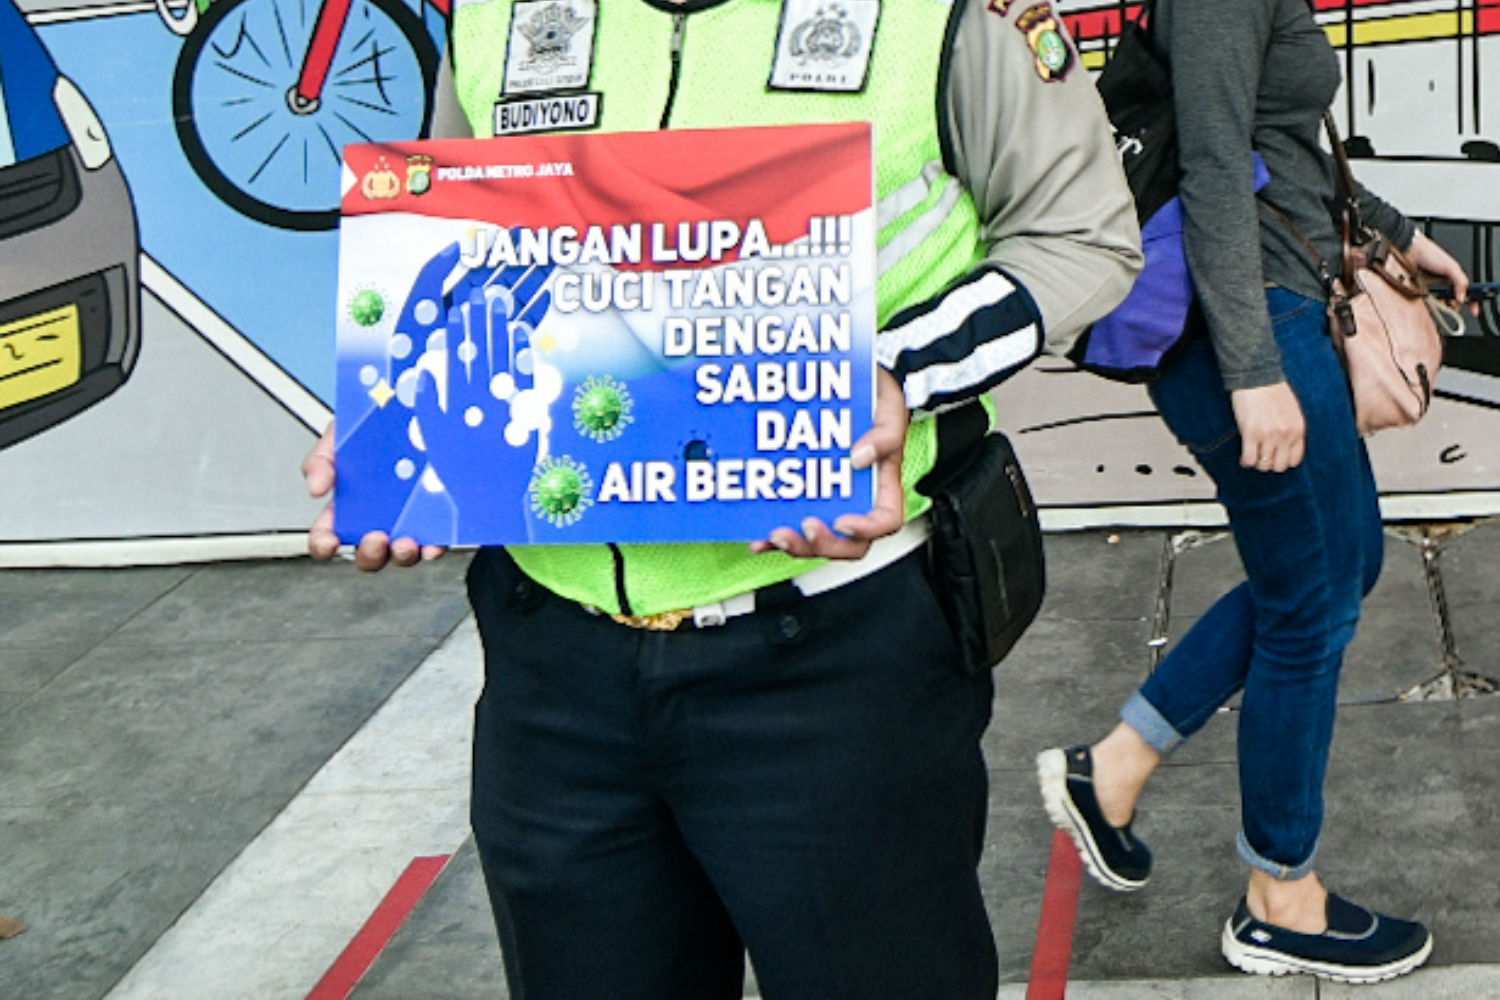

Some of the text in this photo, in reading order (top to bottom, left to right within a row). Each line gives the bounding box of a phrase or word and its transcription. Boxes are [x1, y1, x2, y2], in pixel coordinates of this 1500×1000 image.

[500, 98, 590, 131] BUDIYONO
[438, 166, 483, 180] POLDA
[536, 163, 574, 176] JAYA
[460, 223, 642, 269] JANGAN
[554, 263, 851, 313] CUCI TANGAN
[664, 312, 851, 357] DENGAN
[695, 360, 851, 405] SABUN
[756, 408, 851, 451] DAN
[598, 458, 851, 502] AIR BERSIH
